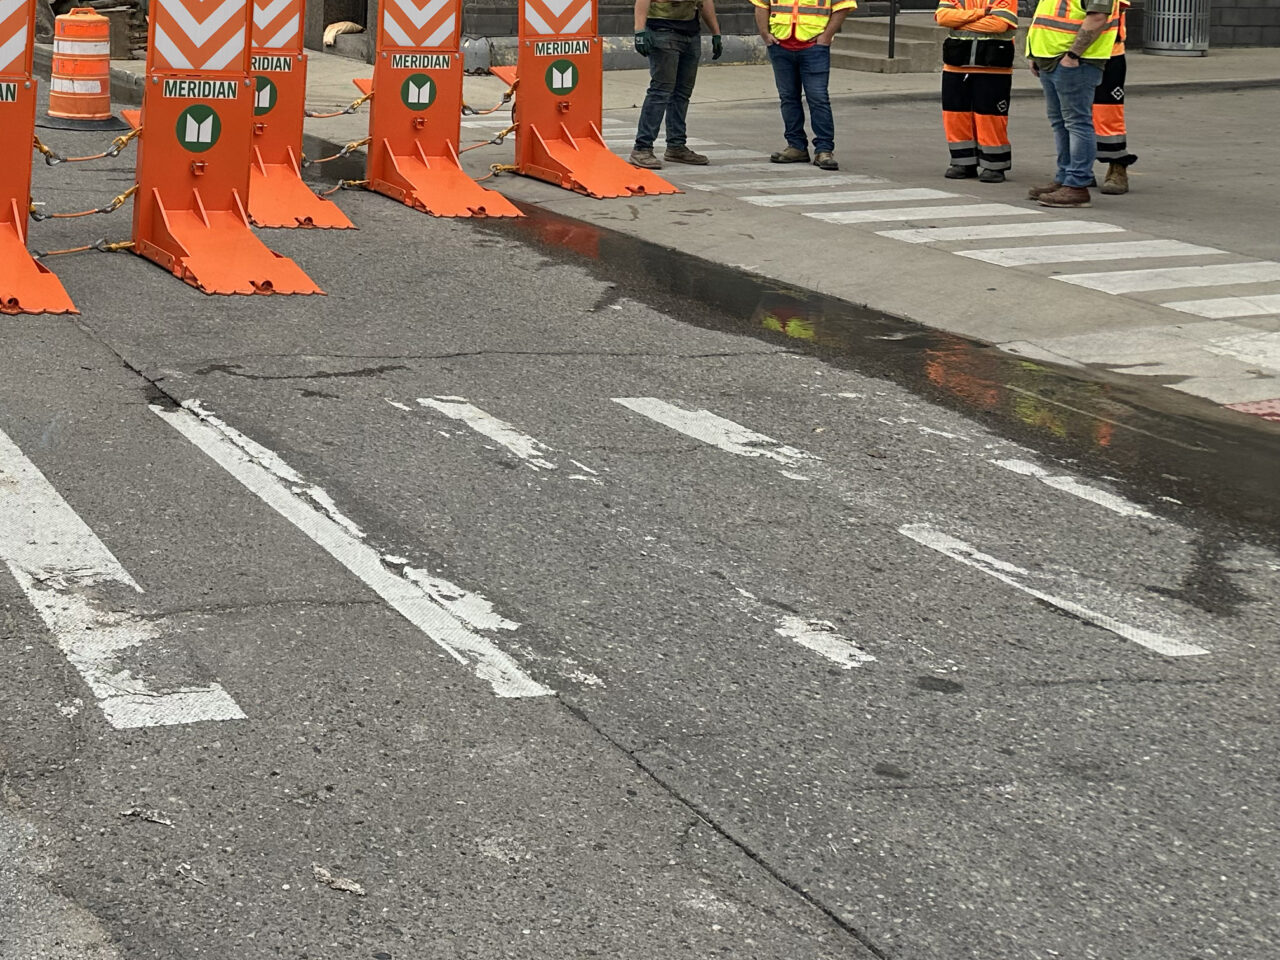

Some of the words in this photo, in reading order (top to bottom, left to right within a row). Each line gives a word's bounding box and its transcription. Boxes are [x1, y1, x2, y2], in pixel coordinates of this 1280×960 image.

[535, 41, 589, 56] MERIDIAN
[251, 56, 291, 72] RIDIAN
[392, 54, 450, 68] MERIDIAN
[164, 80, 237, 99] MERIDIAN
